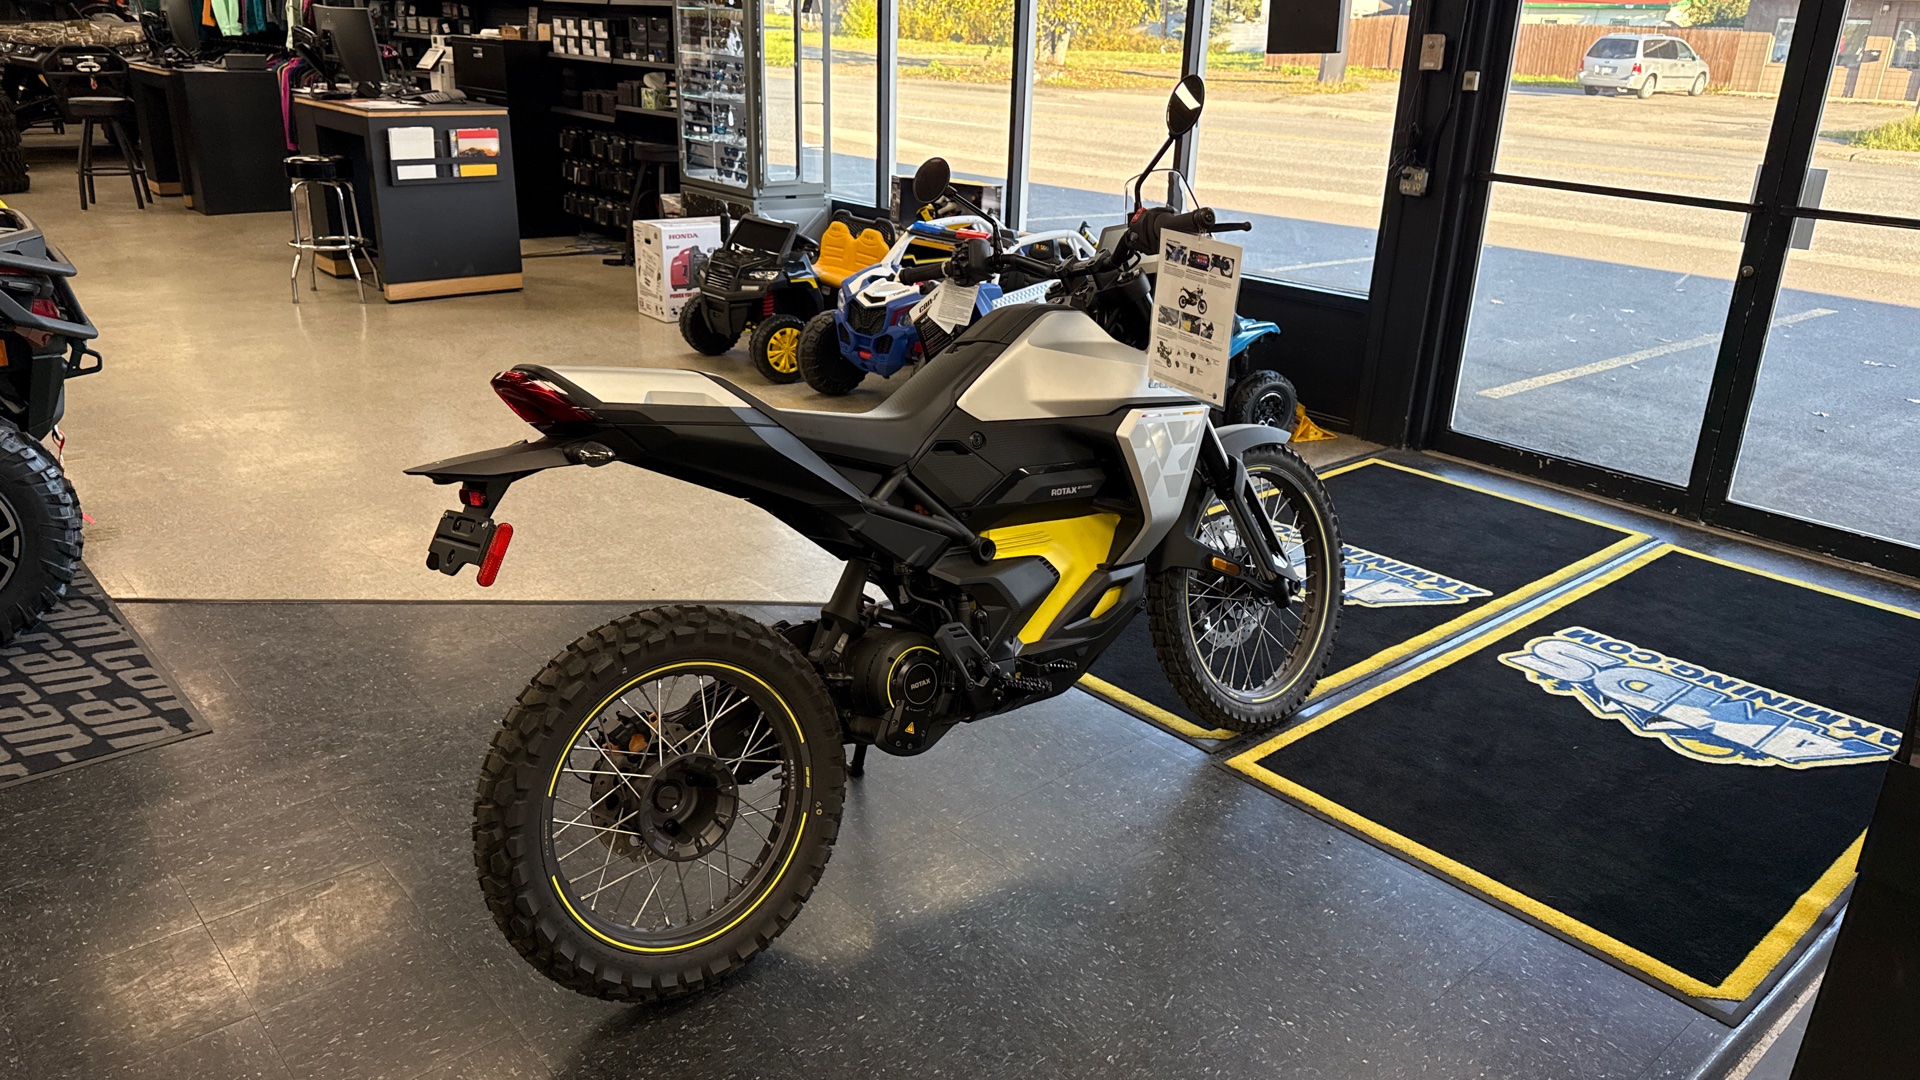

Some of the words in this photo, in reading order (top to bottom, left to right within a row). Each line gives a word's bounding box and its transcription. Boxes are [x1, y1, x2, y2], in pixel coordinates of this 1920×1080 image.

[1051, 486, 1077, 497] ROTAX
[910, 677, 931, 690] ROTAX
[1562, 628, 1902, 747] AKMINING.COM
